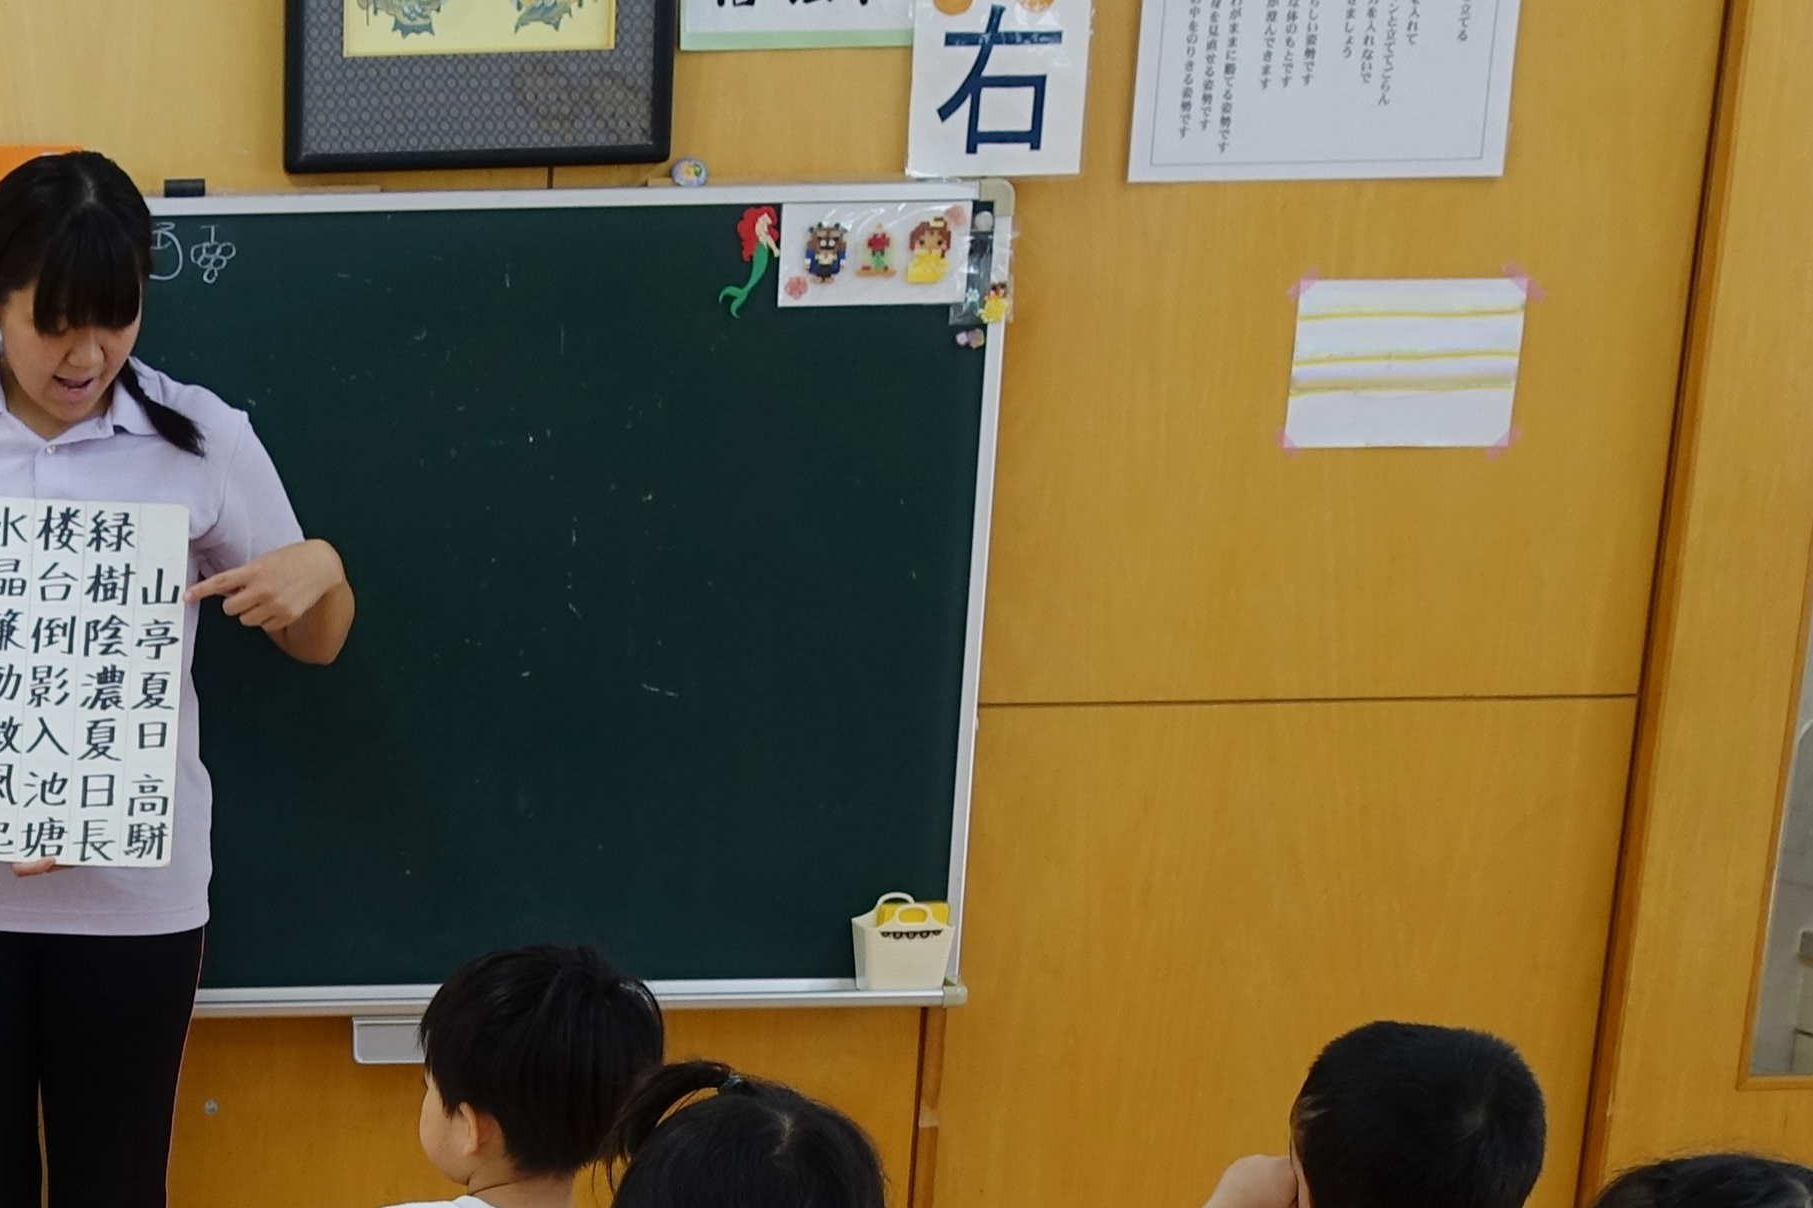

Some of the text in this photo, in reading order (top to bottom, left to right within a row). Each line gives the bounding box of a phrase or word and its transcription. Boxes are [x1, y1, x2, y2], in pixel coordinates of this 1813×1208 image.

[1456, 0, 1472, 41] 立てる
[937, 5, 1063, 154] 右
